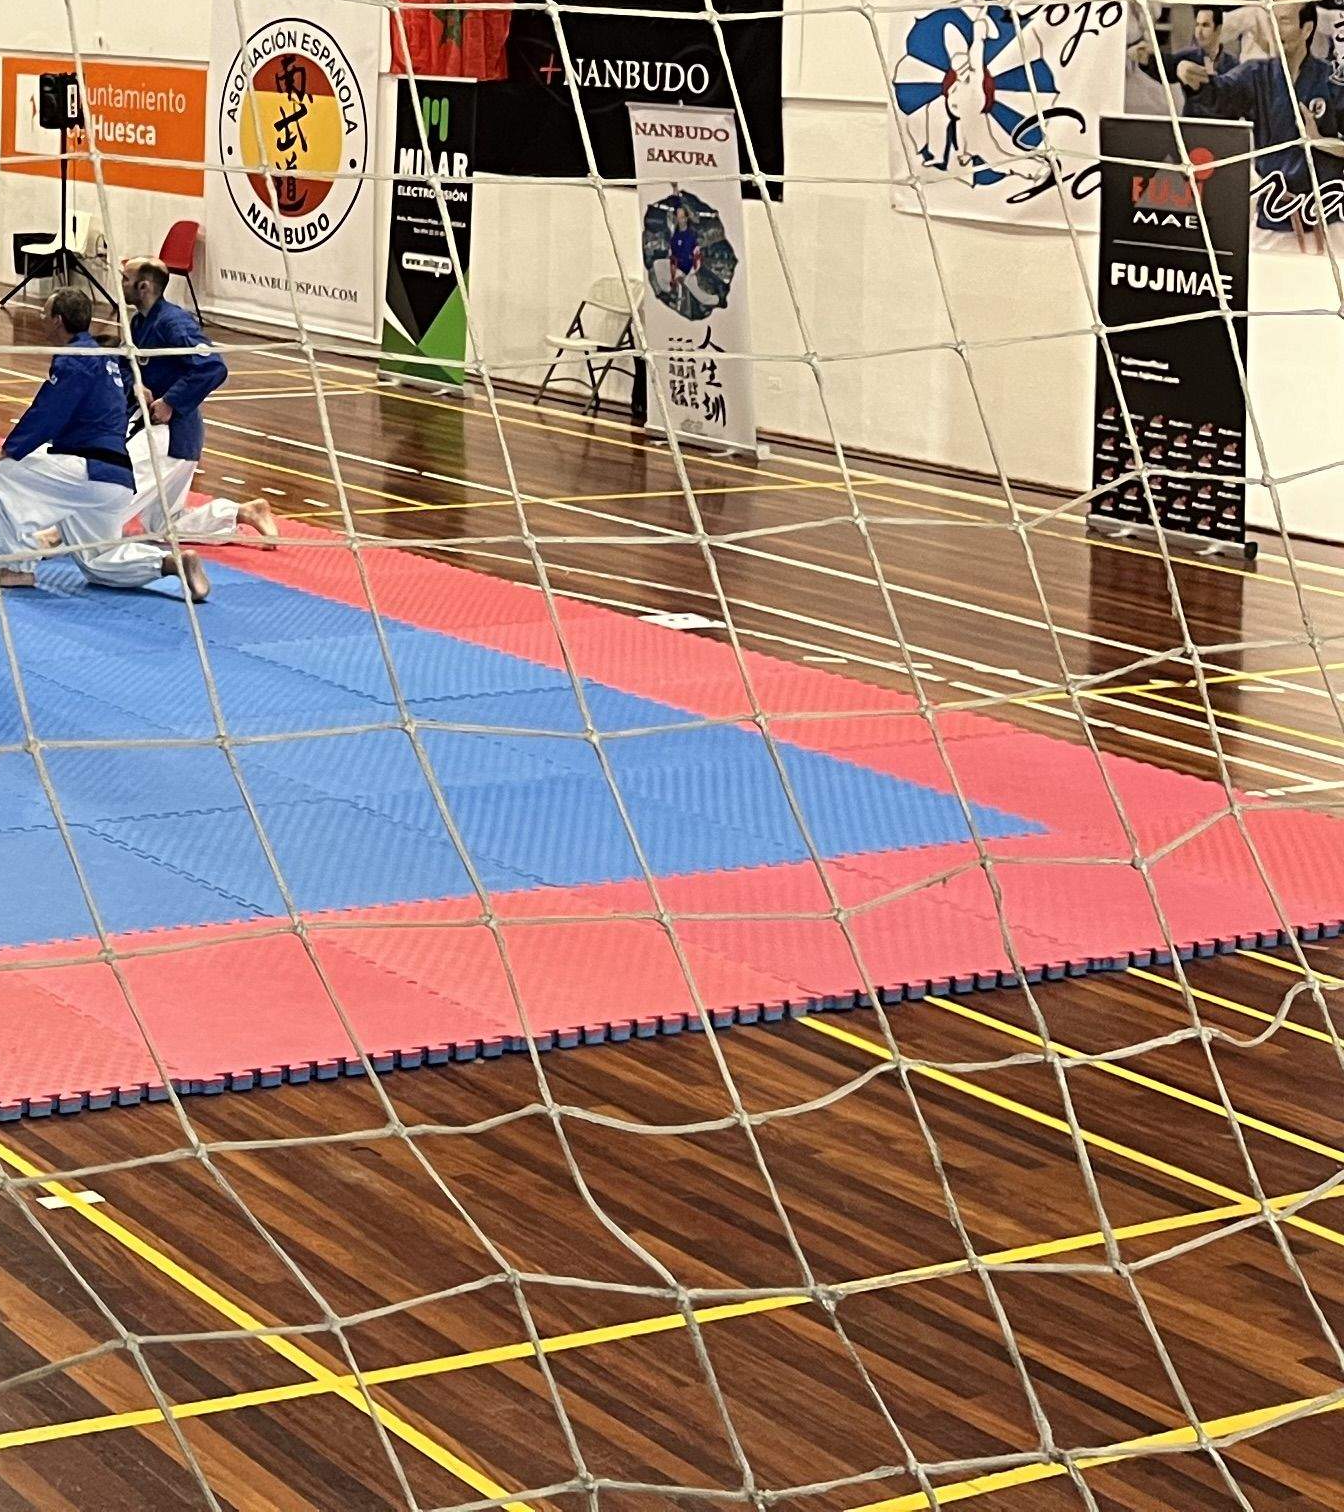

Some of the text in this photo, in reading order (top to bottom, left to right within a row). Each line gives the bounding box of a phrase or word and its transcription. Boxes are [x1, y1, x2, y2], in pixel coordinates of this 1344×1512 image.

[79, 83, 187, 114] untamiento
[301, 32, 358, 134] ESPAÑOLA
[92, 114, 157, 146] Huesca
[634, 122, 730, 142] NANBUDO
[647, 147, 718, 168] SAKURA
[247, 202, 330, 245] NANBUDO
[1132, 210, 1201, 230] MAE
[1111, 262, 1233, 300] FUJIMAE
